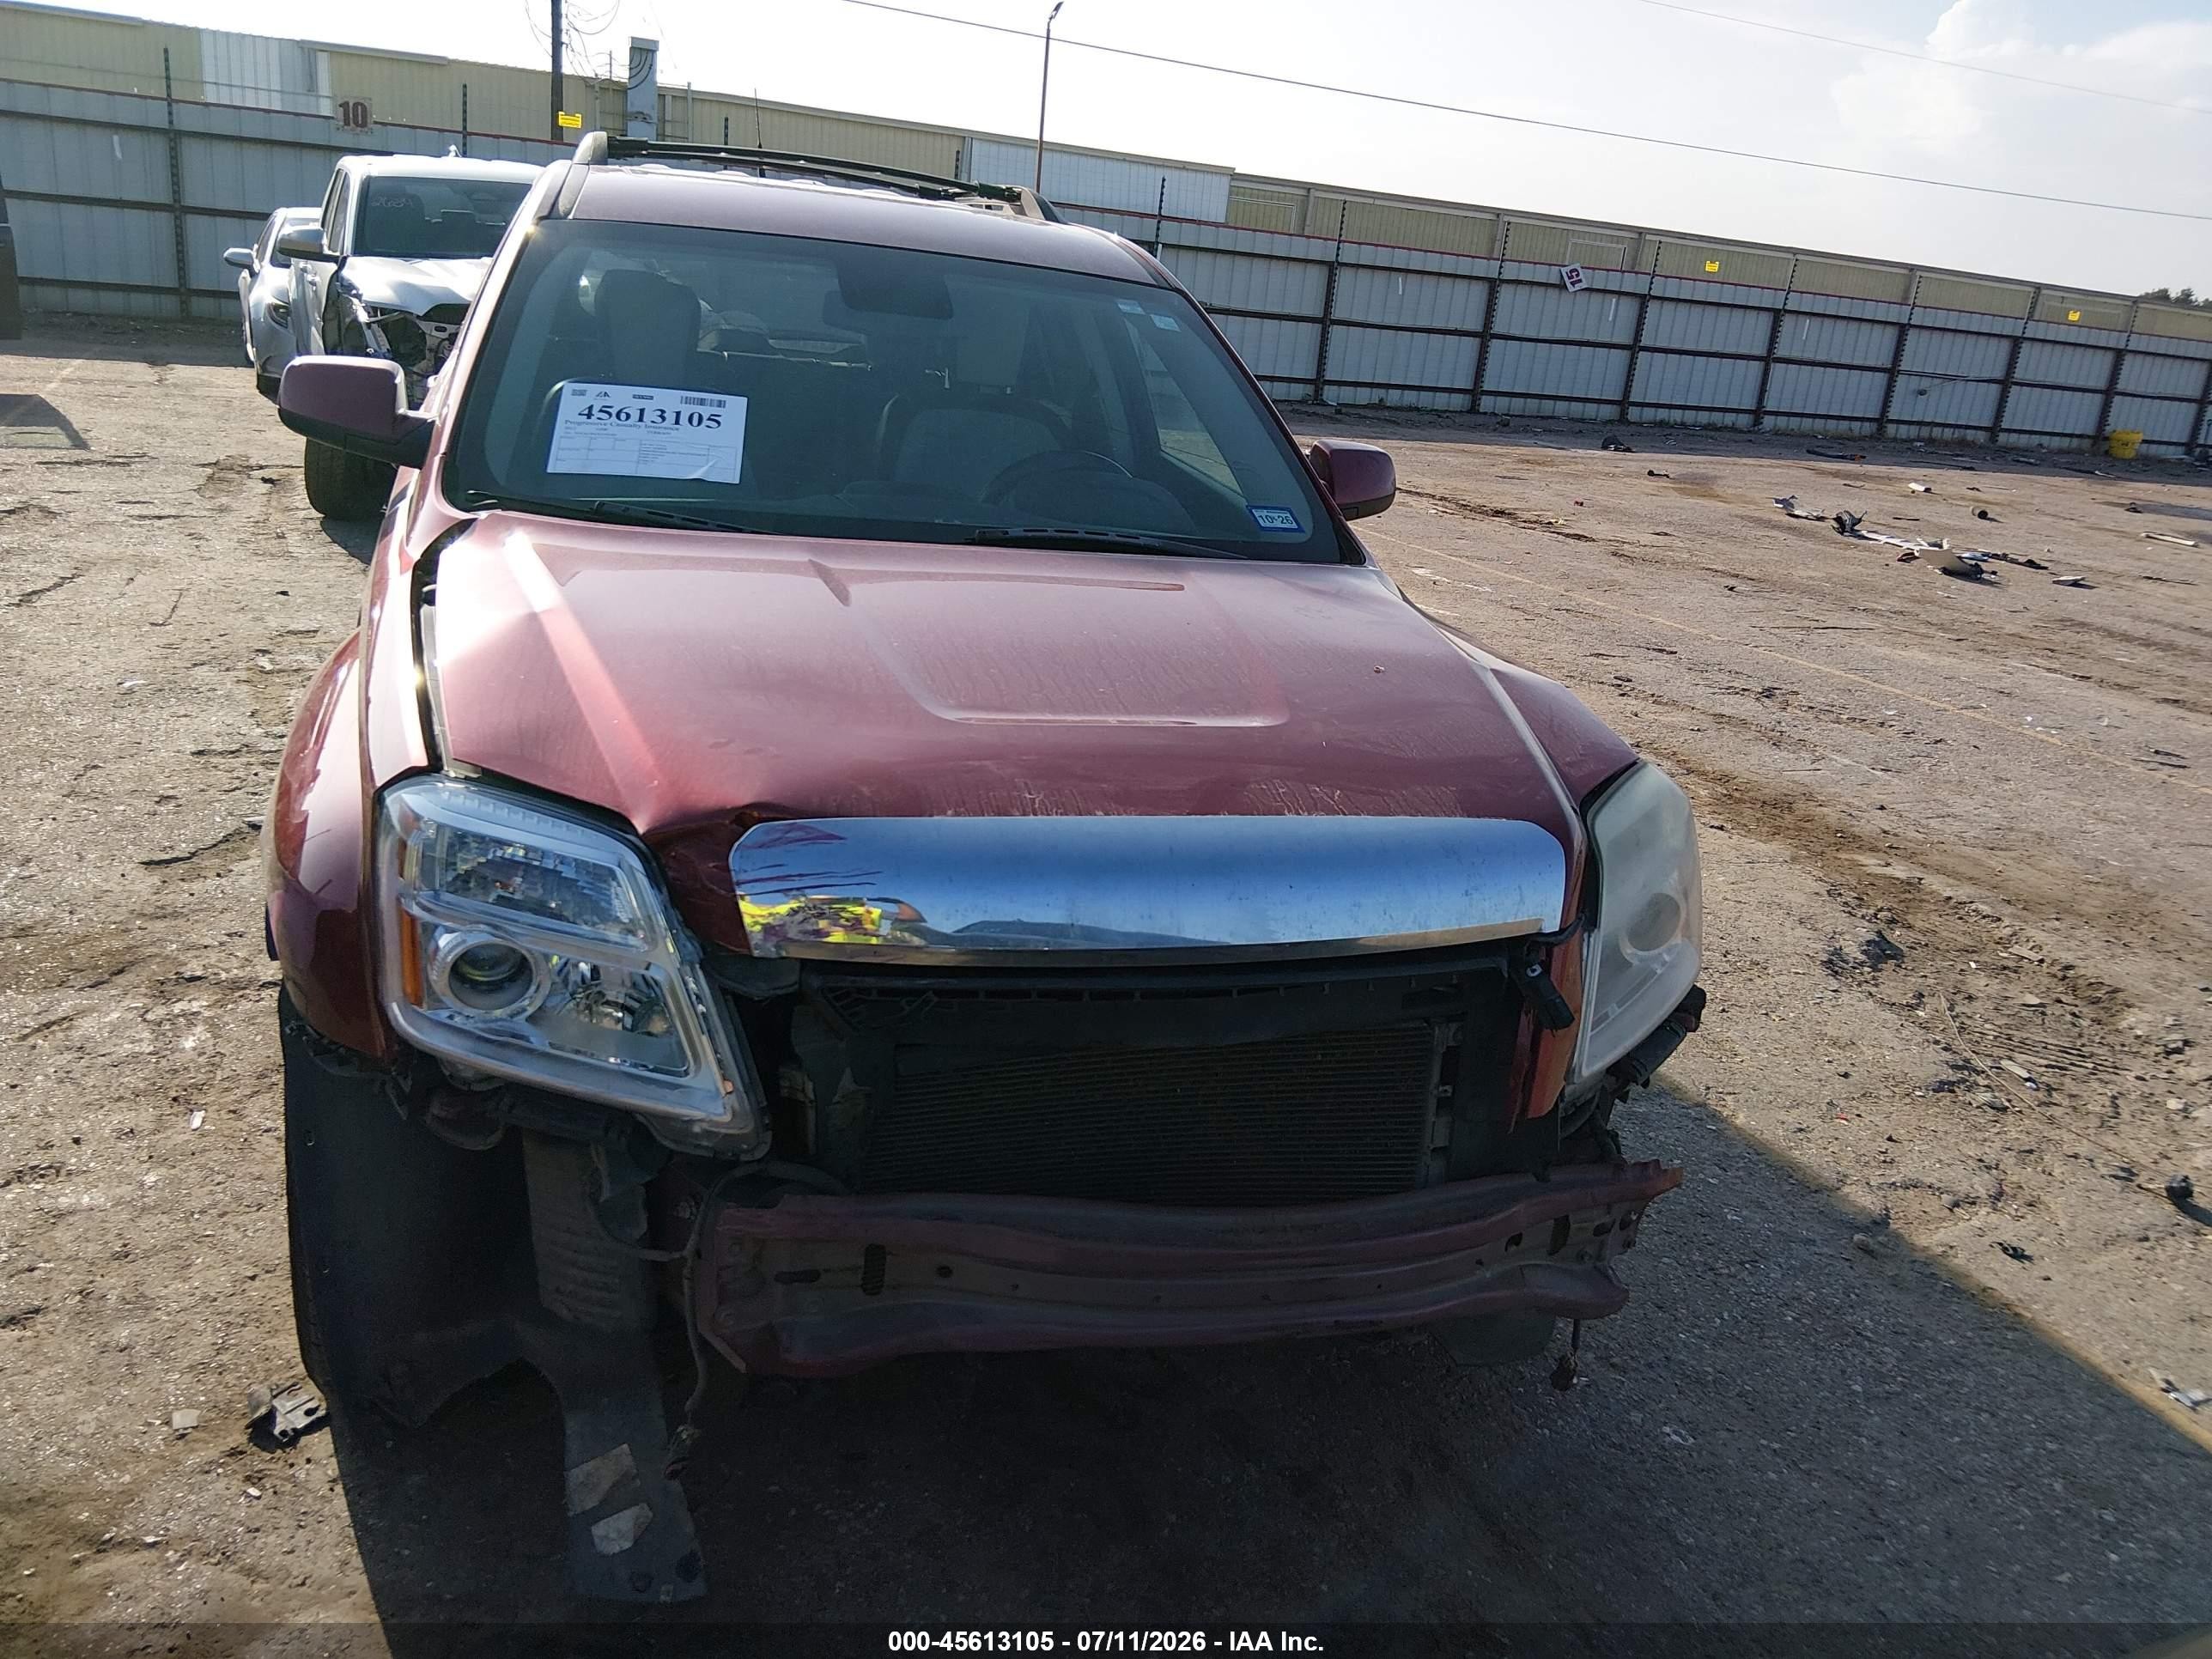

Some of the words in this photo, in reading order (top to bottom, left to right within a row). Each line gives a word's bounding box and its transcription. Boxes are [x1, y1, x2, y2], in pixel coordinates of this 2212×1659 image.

[338, 100, 368, 128] 10
[1565, 268, 1583, 289] 15
[577, 404, 723, 429] 45613105
